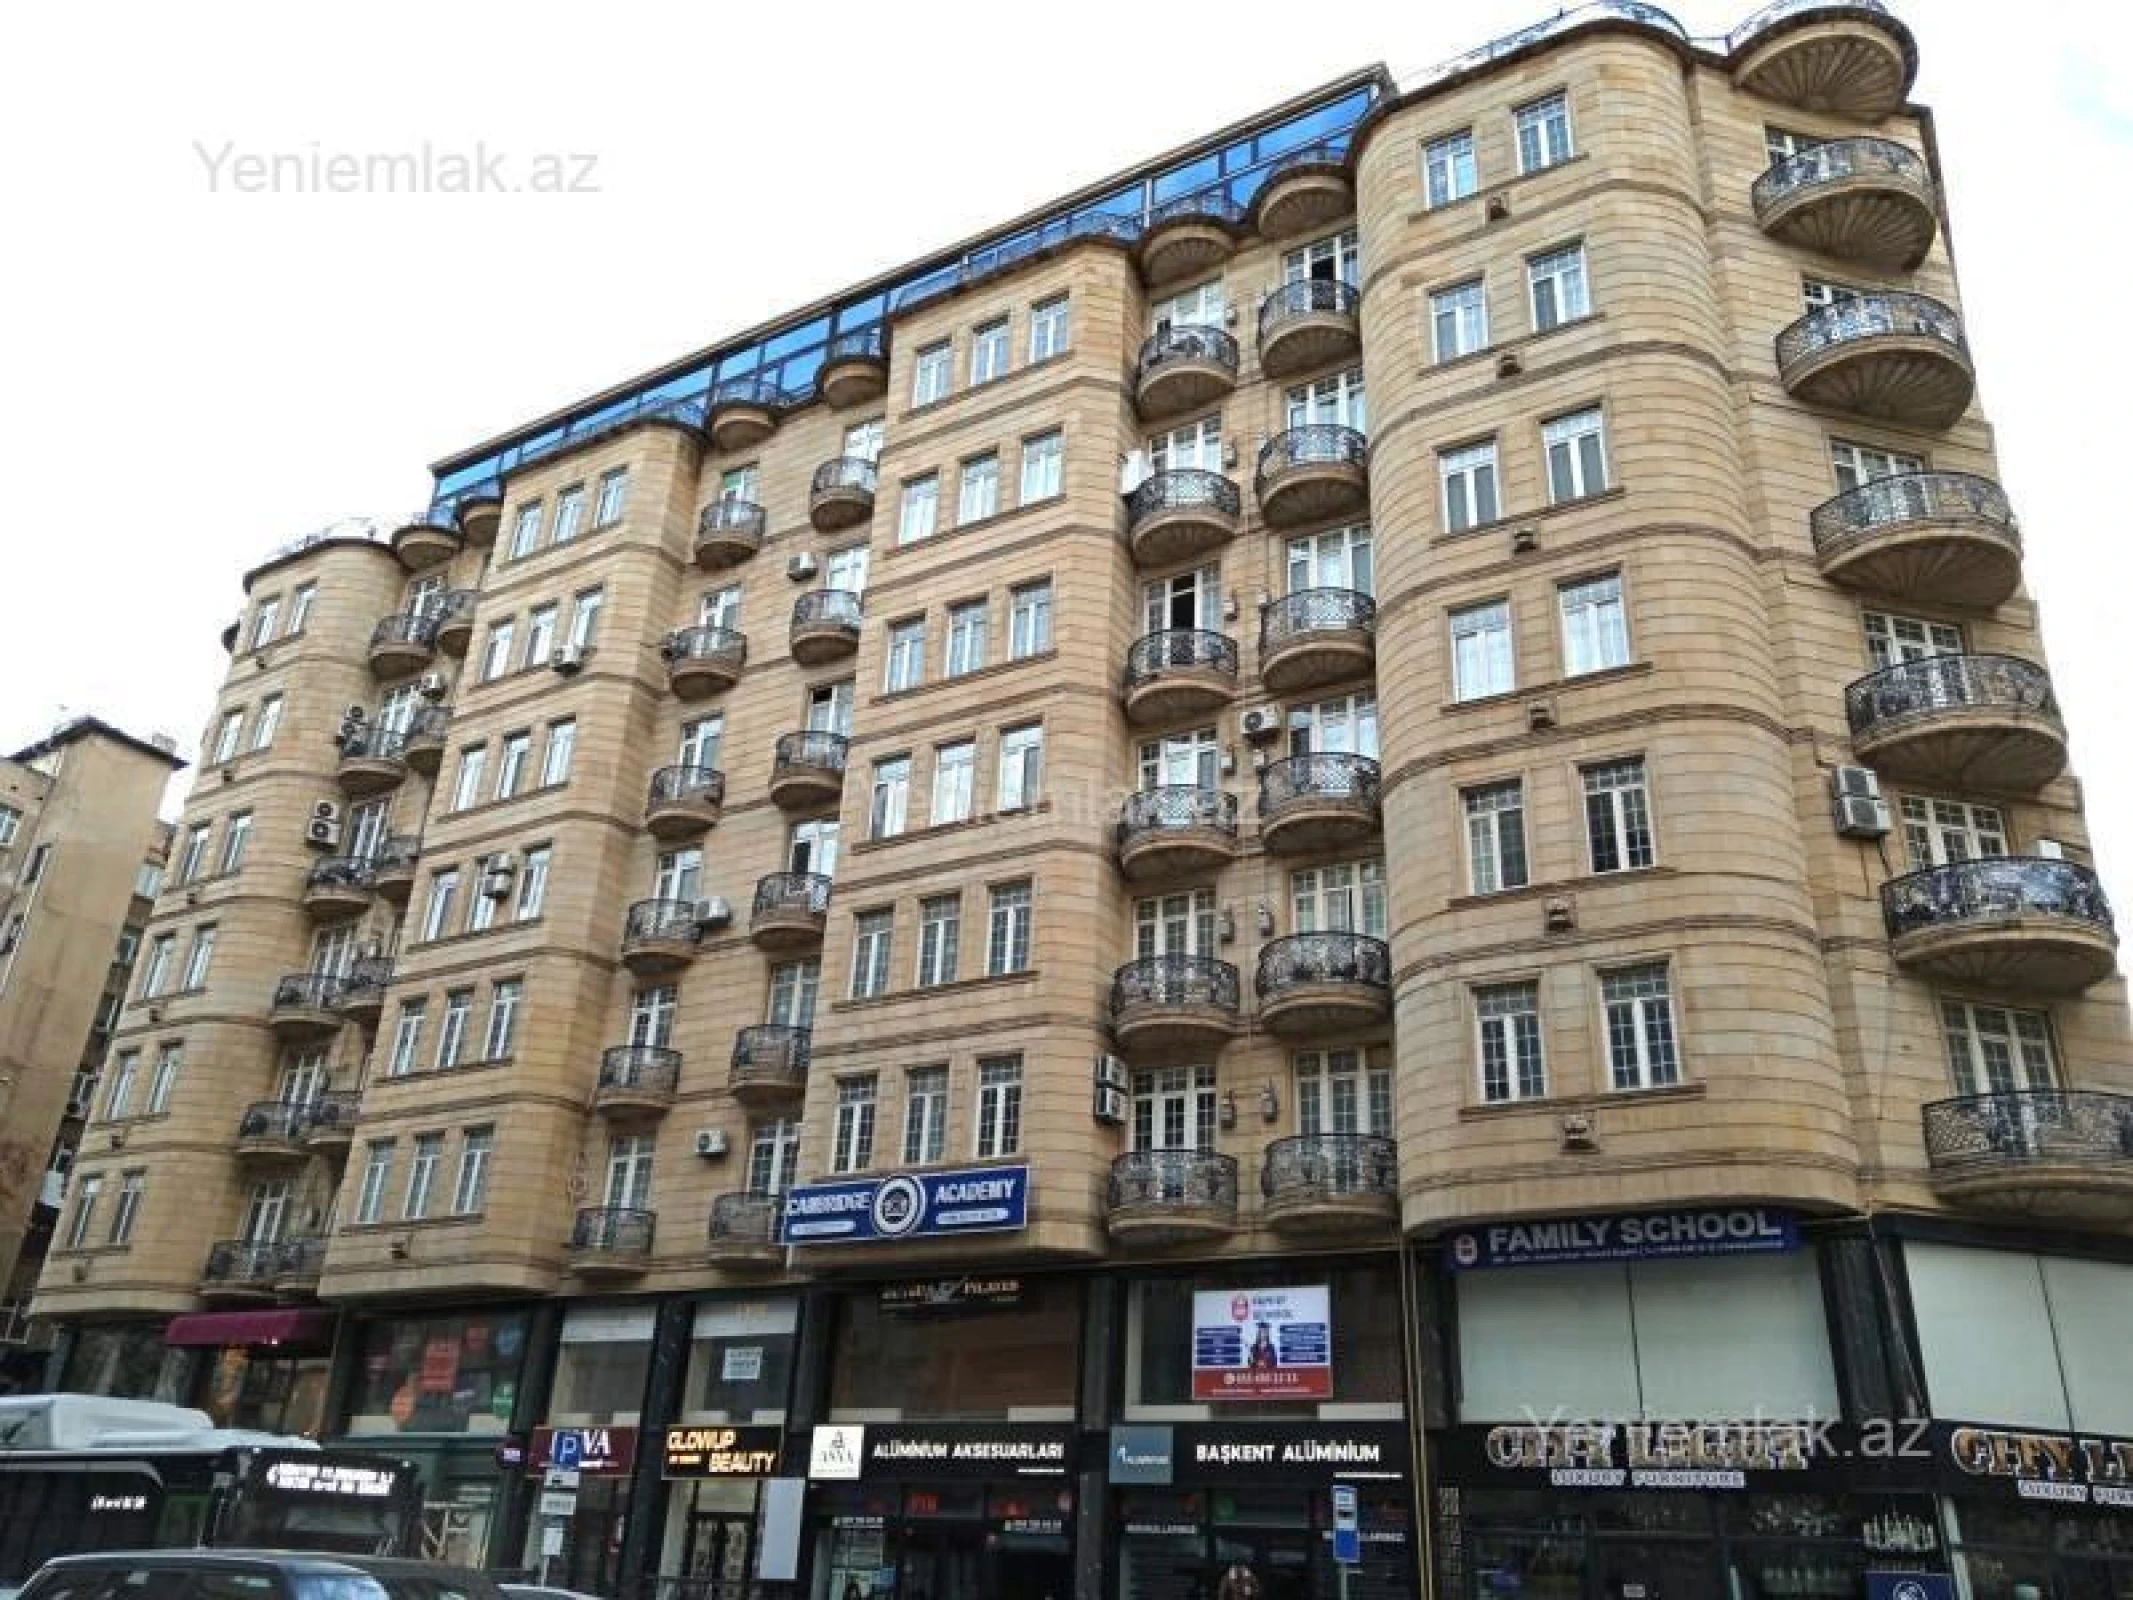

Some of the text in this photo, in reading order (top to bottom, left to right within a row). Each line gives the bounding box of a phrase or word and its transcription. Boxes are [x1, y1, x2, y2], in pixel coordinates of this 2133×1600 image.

[934, 1179, 1017, 1204] ACADEMY
[1489, 1219, 1610, 1253] FAMILY
[1620, 1209, 1783, 1244] SCHOOL
[708, 1451, 775, 1473] BEAUTY
[1195, 1444, 1275, 1464] BAŞKENT
